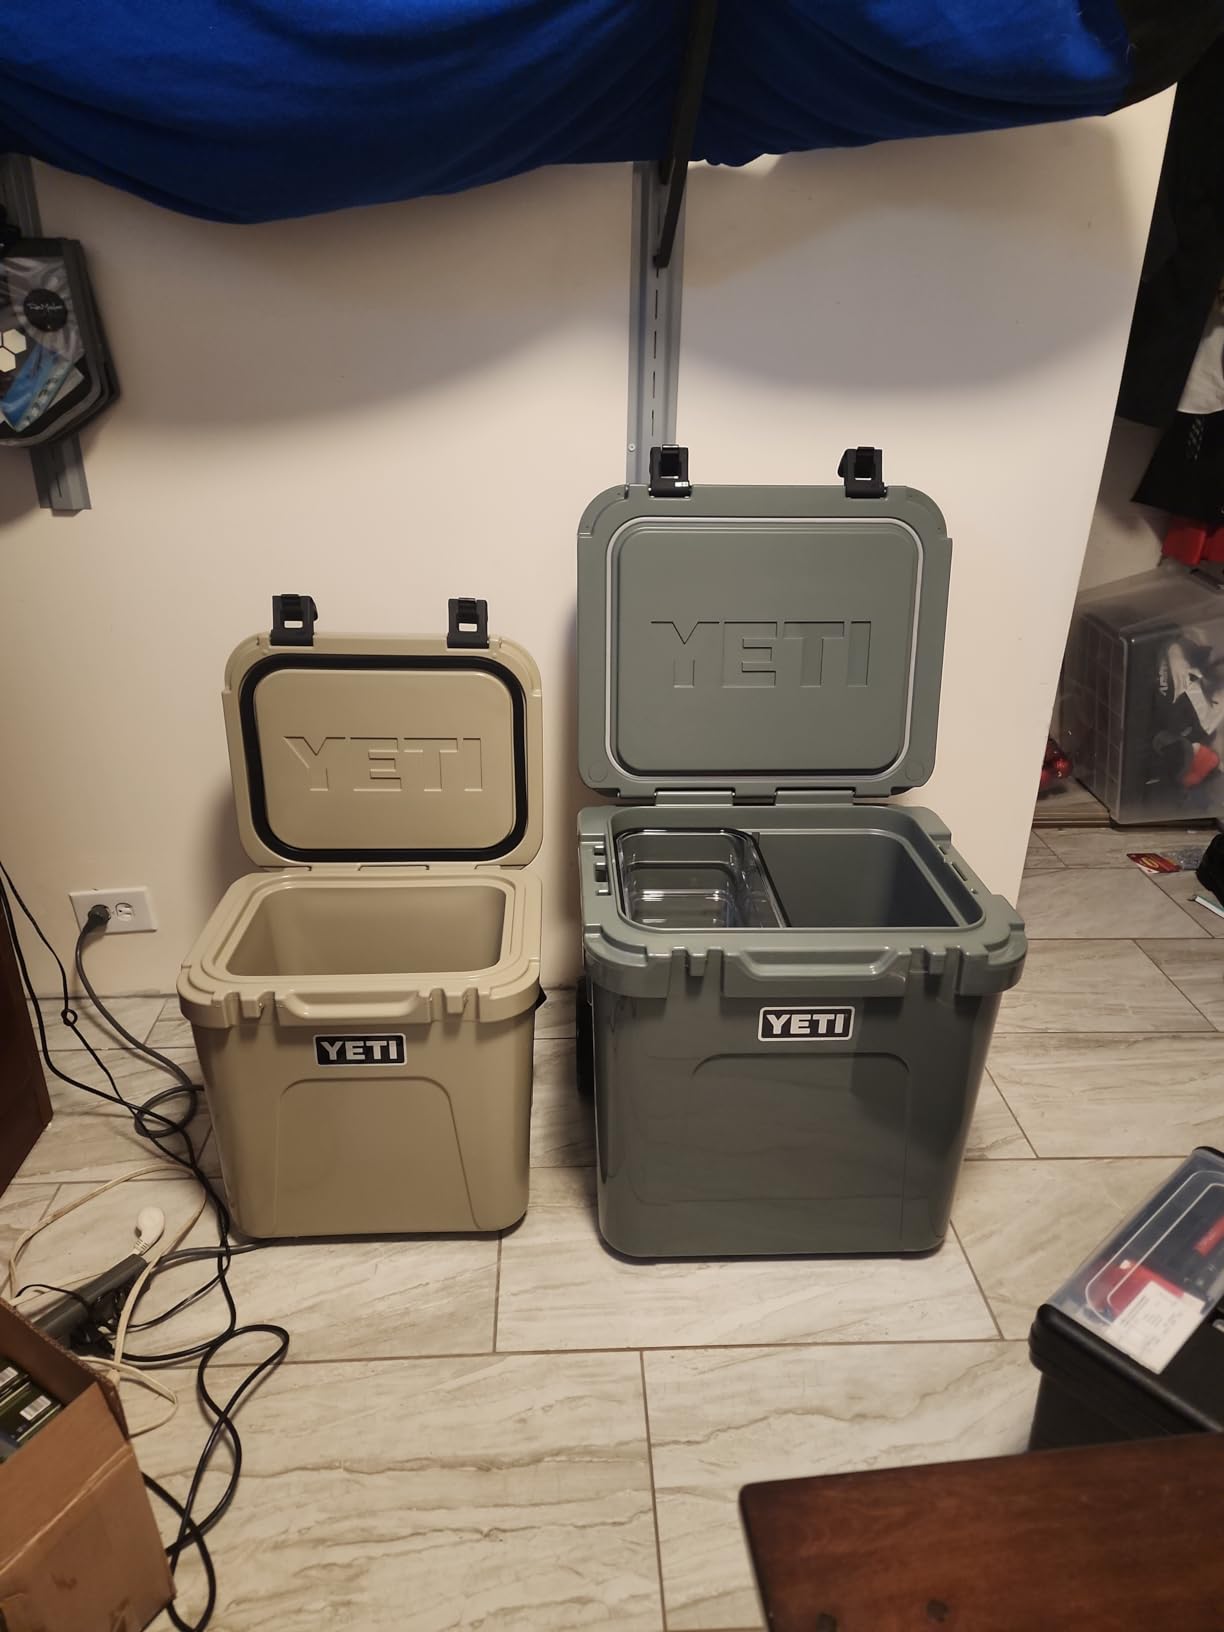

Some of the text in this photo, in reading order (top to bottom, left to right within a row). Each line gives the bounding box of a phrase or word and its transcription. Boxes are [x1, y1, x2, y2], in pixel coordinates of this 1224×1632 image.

[649, 618, 873, 689] YETI
[283, 735, 484, 792] YETI
[765, 1013, 845, 1035] YETI
[319, 1040, 398, 1061] YETI
